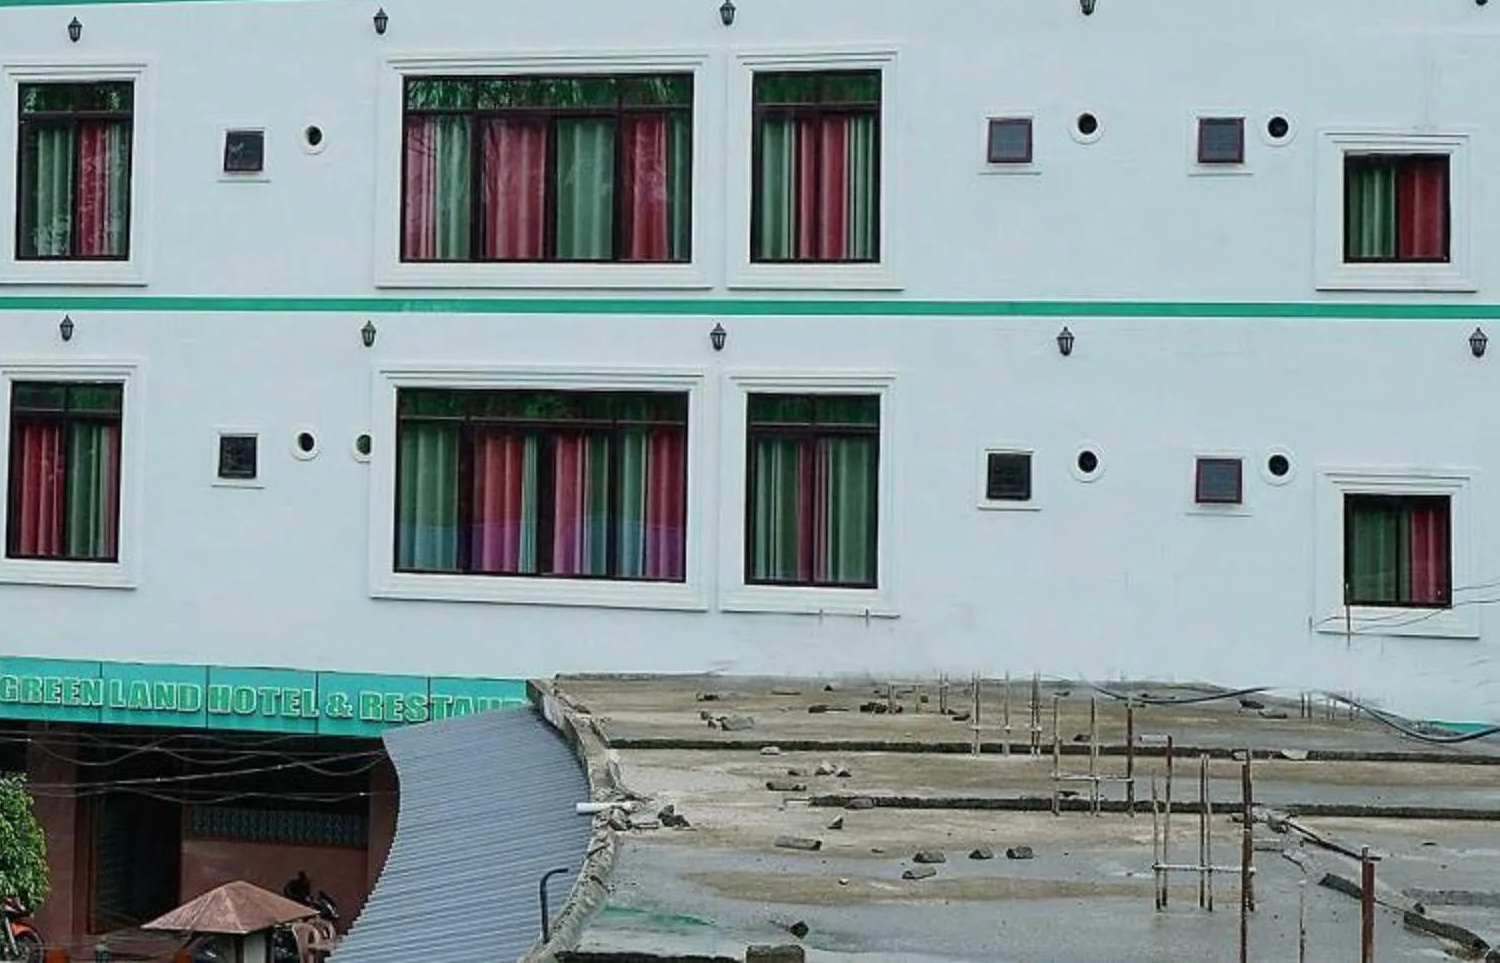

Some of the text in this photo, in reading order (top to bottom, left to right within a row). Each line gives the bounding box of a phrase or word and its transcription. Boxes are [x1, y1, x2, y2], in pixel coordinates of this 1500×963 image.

[108, 680, 202, 712] LAND
[208, 685, 319, 717] HOTEL
[325, 693, 353, 719] &
